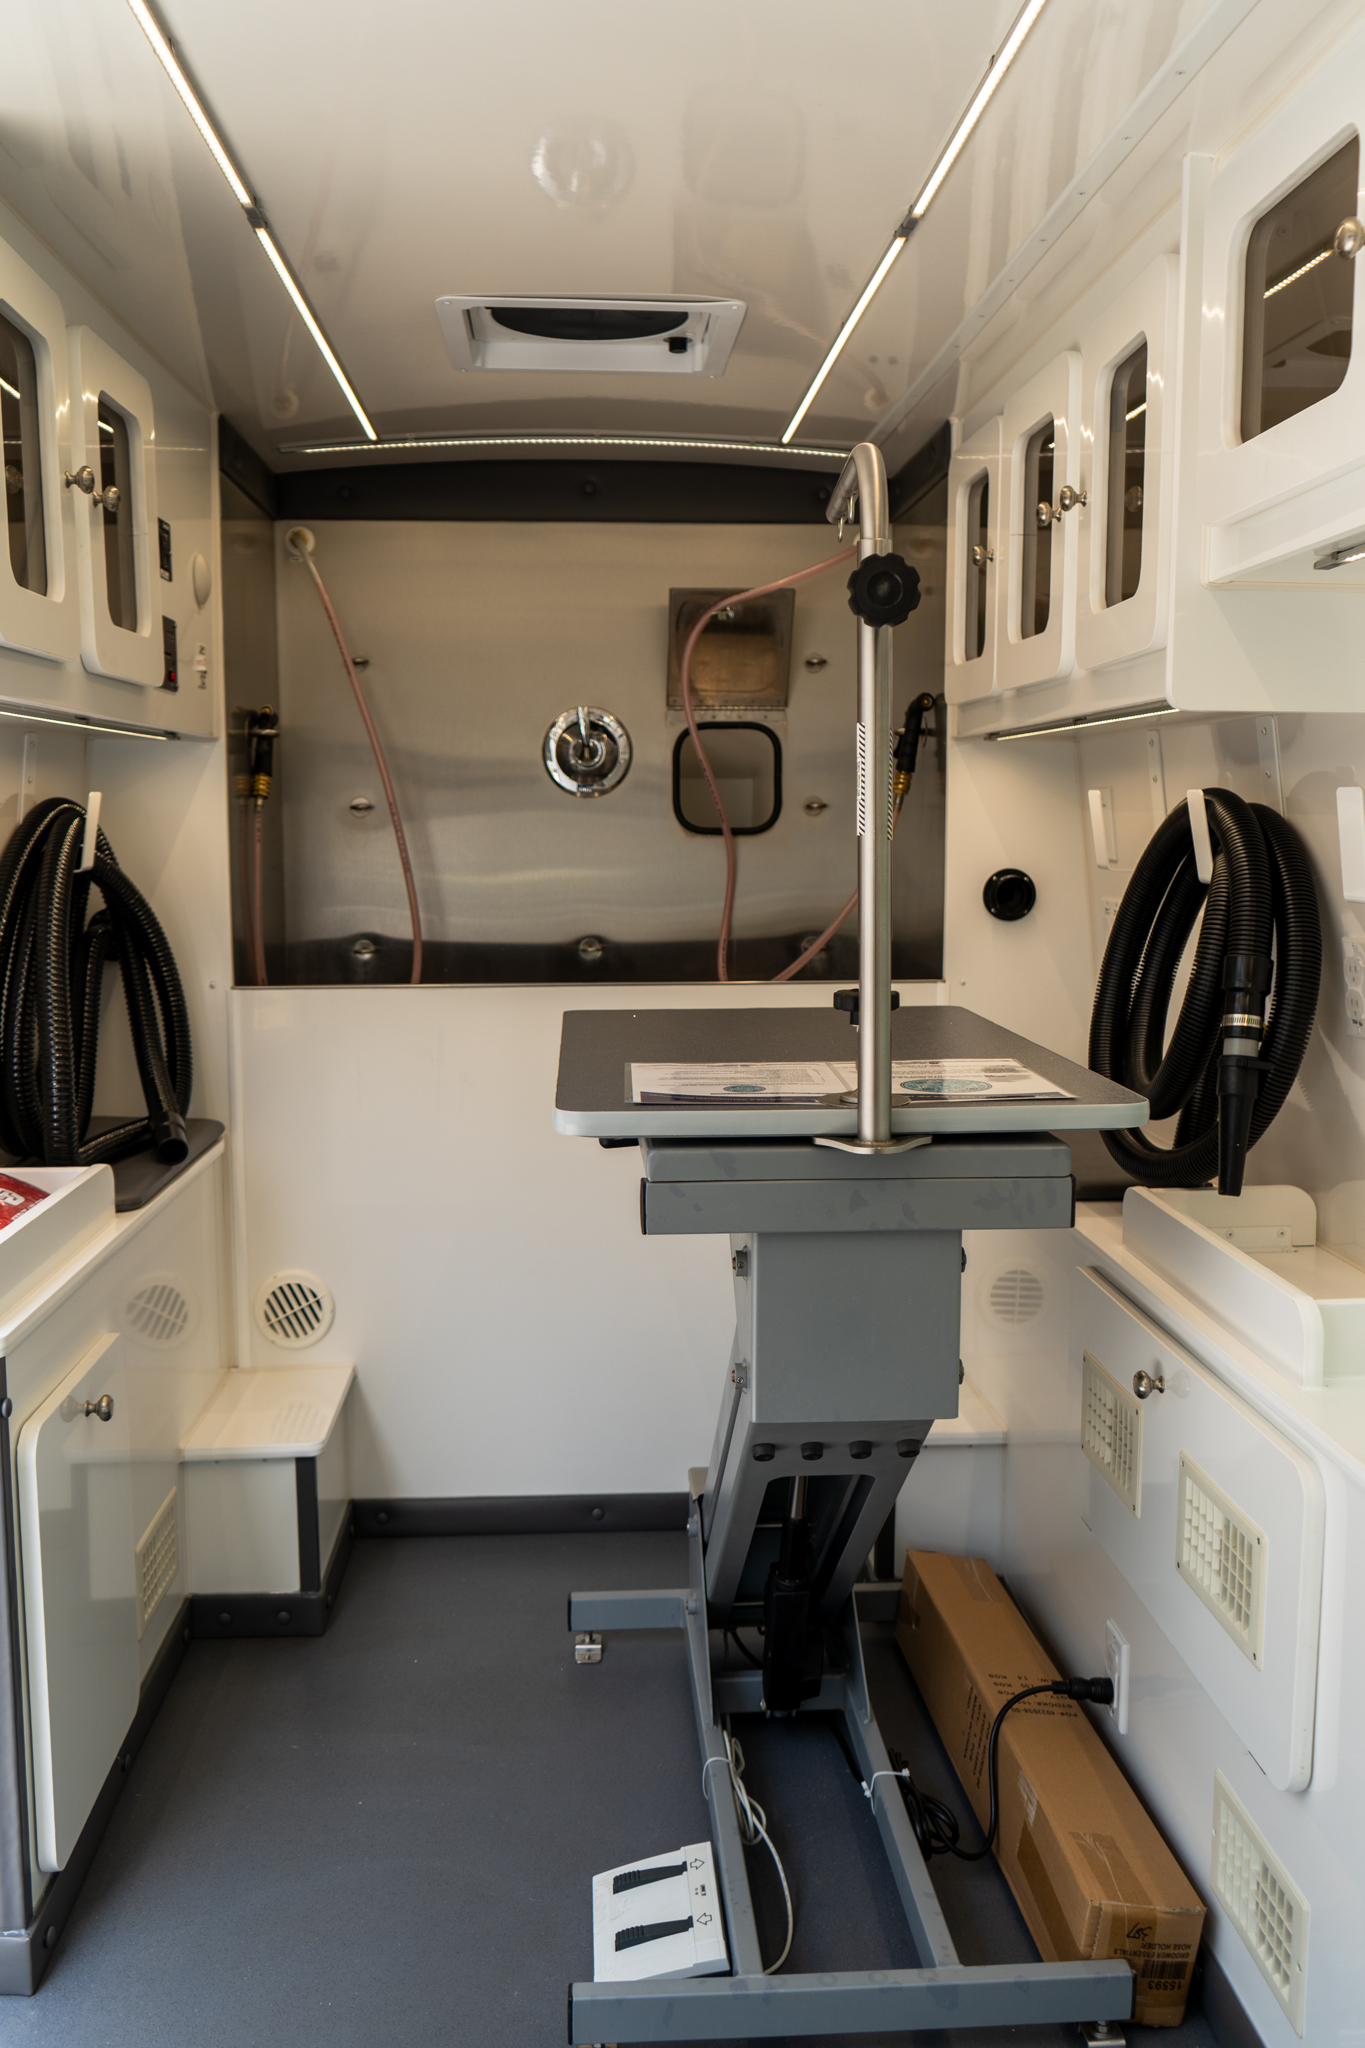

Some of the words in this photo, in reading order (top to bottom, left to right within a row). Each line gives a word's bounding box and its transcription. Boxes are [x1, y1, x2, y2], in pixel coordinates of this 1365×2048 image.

[1141, 1942, 1172, 1951] HOLDER
[1173, 1943, 1192, 1951] HOSE
[1114, 1948, 1155, 1958] ESSENTIALS
[1148, 1980, 1182, 1991] 15593
